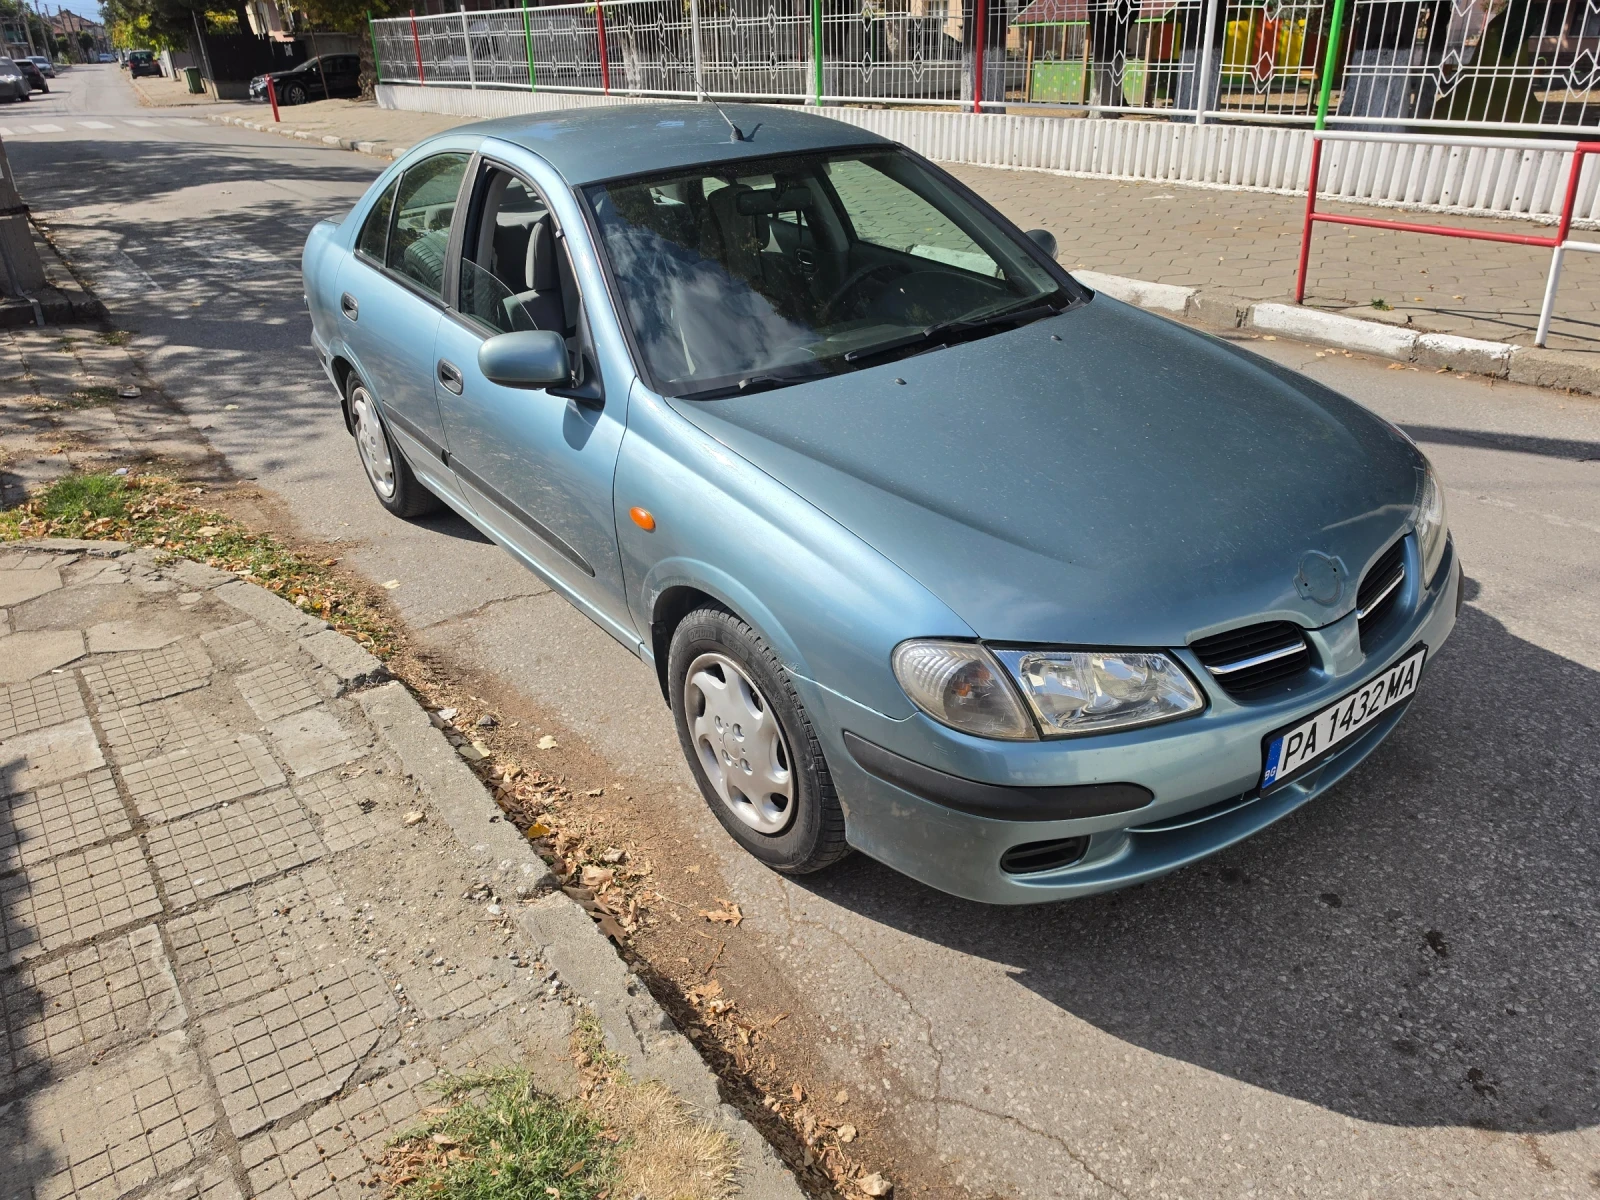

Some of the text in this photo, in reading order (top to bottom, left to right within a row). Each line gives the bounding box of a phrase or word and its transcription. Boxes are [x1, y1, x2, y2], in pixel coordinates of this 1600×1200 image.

[1282, 660, 1416, 771] PA 1432 MA
[1264, 767, 1277, 780] BG
